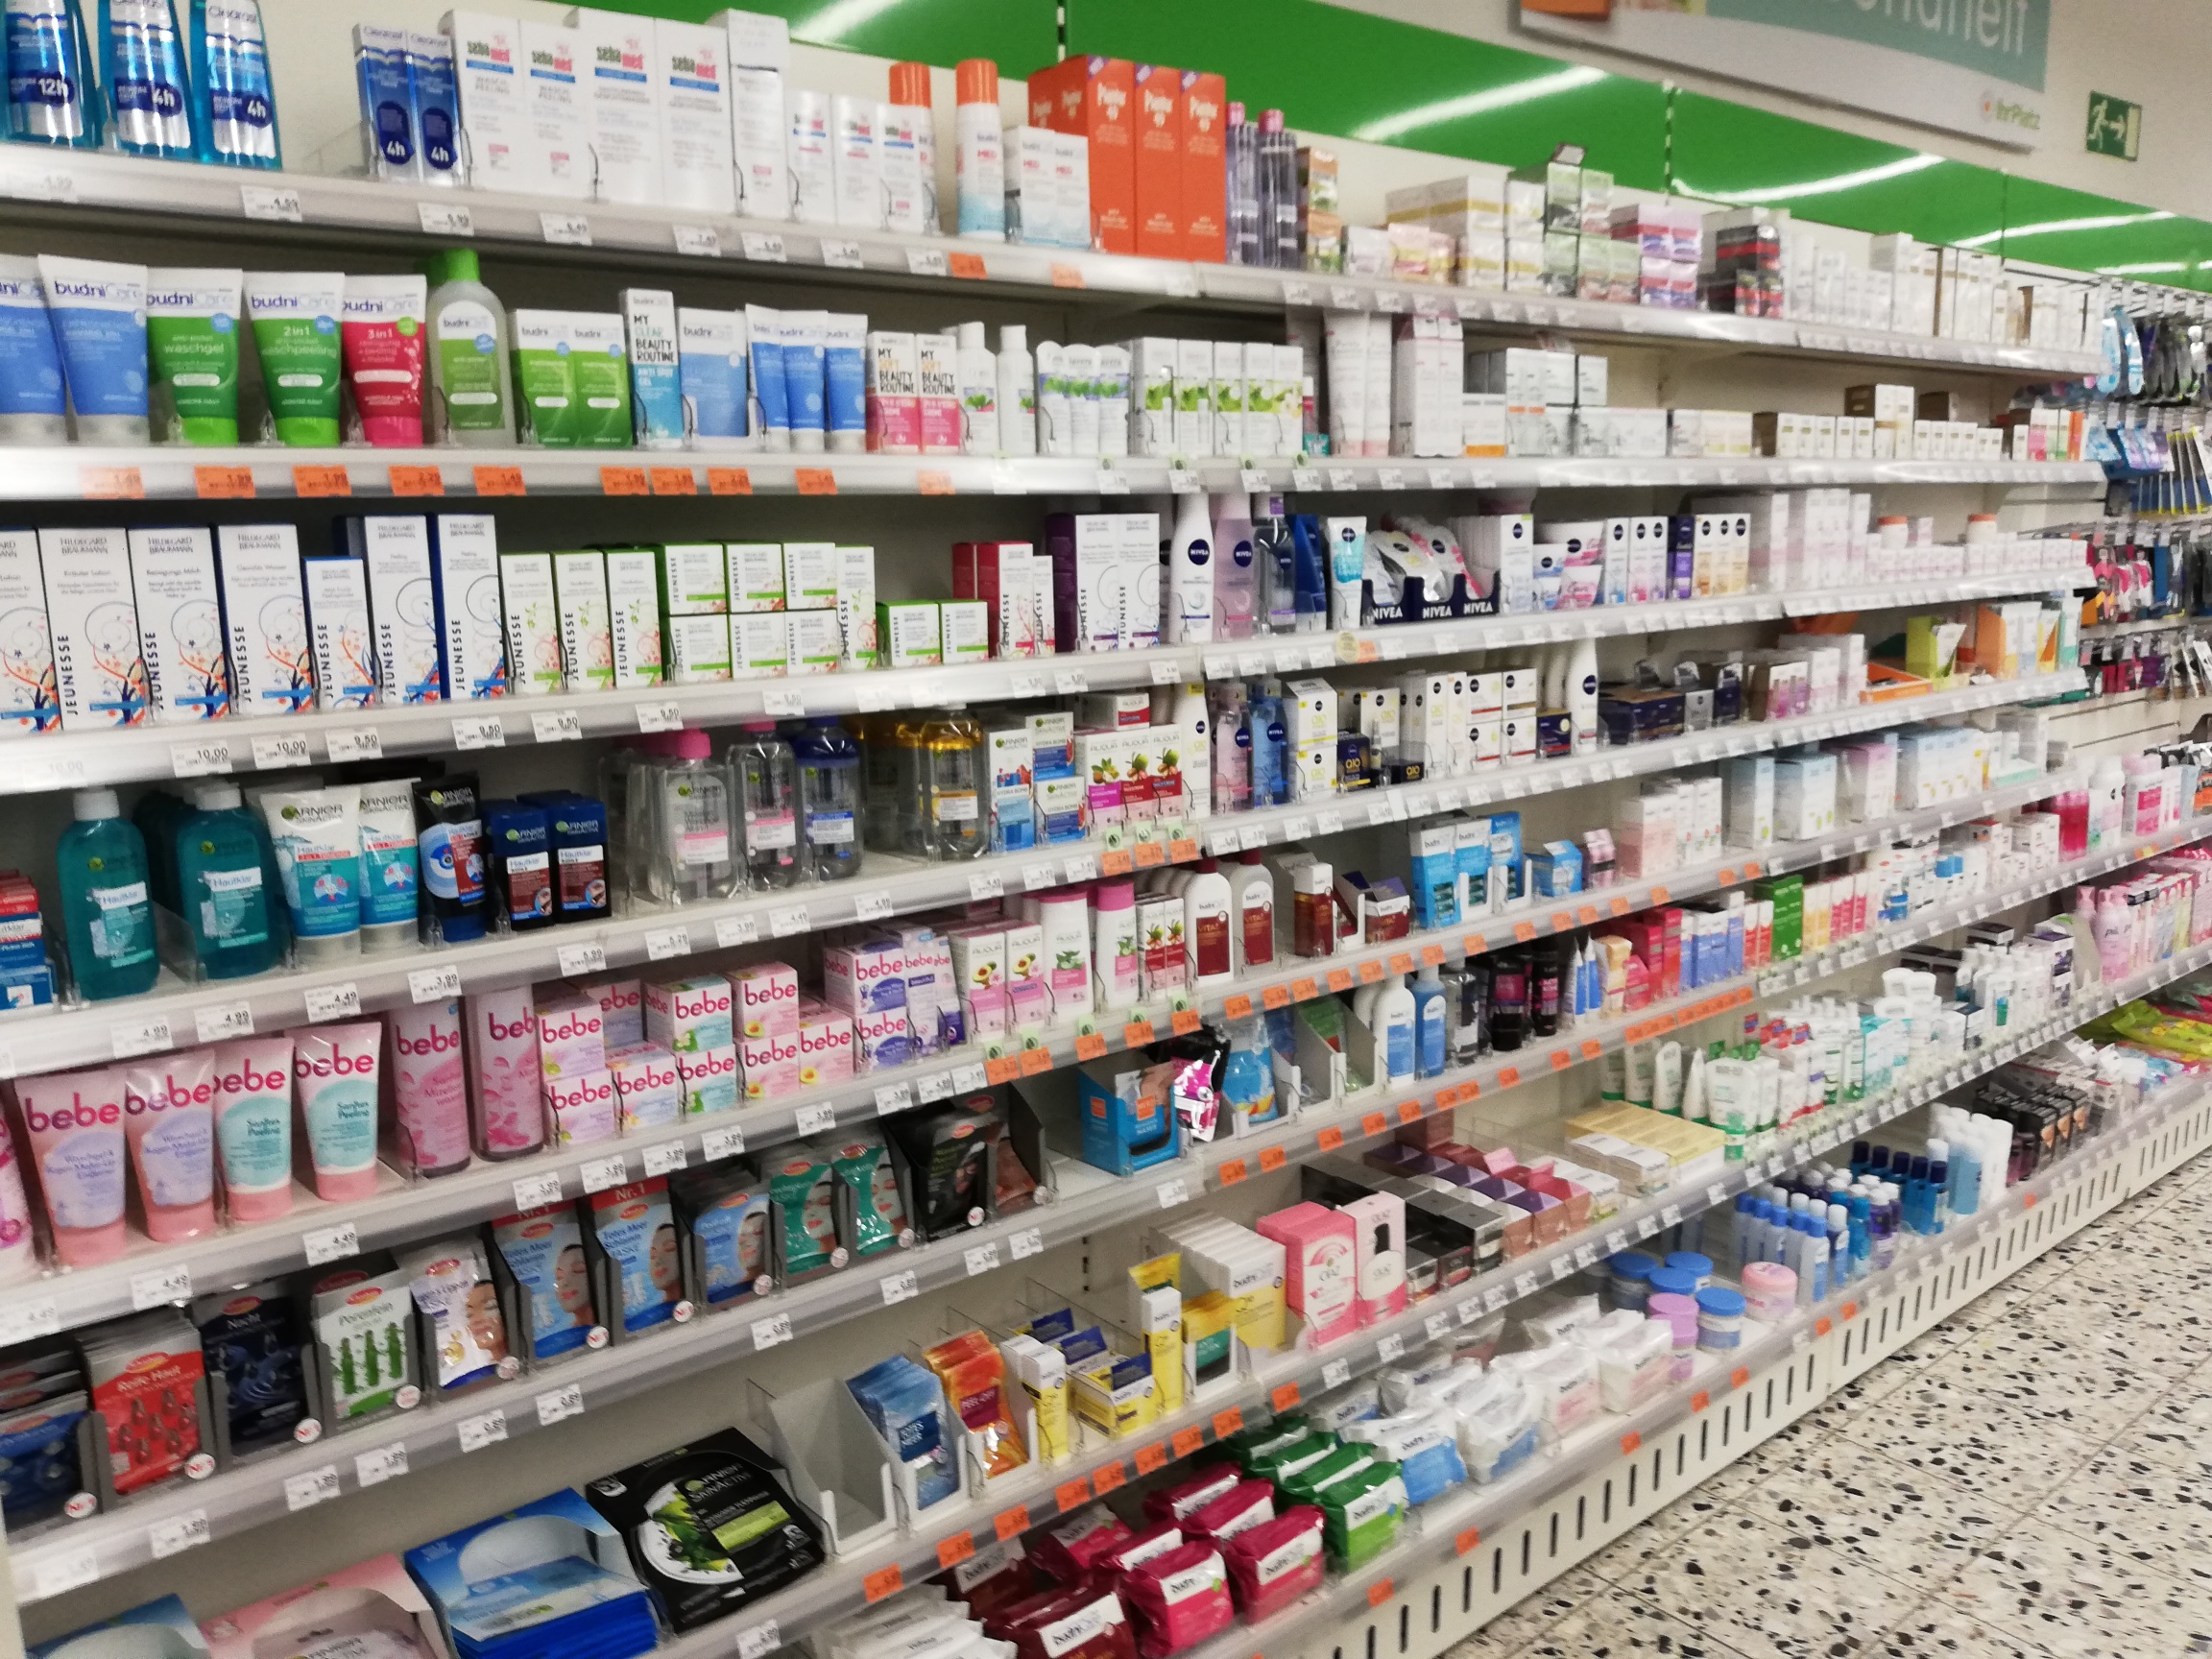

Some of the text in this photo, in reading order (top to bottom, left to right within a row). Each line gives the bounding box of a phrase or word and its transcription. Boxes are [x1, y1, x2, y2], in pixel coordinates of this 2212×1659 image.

[246, 100, 266, 118] 4h
[386, 141, 406, 156] 4h
[431, 146, 449, 162] 4h
[636, 339, 672, 351] BEAUTY
[878, 371, 913, 383] BEAUTY
[922, 373, 955, 385] BEAUTY
[1189, 548, 1210, 558] NIVEA
[1373, 607, 1404, 619] NIVEA
[1422, 606, 1453, 618] NIVEA
[1463, 602, 1494, 614] NIVEA
[451, 618, 466, 690] JEUNESSE
[614, 610, 629, 678] JEUNESSE
[233, 625, 252, 703] JEUNESSE
[316, 624, 334, 700] JEUNESSE
[380, 623, 397, 697] JEUNESSE
[58, 635, 79, 716] JEUNESSE
[854, 953, 903, 981] bebe
[904, 953, 934, 971] bebe
[675, 990, 731, 1020] bebe
[744, 977, 797, 1006] bebe
[396, 1024, 460, 1057] bebe
[542, 1012, 602, 1044] bebe
[800, 1025, 853, 1055] bebe
[858, 1013, 906, 1041] bebe
[294, 1043, 375, 1079] bebe
[678, 1047, 735, 1081] bebe
[744, 1040, 798, 1068] bebe
[550, 1074, 613, 1110] bebe
[617, 1064, 676, 1095] bebe
[125, 1074, 212, 1117] bebe
[25, 1092, 120, 1134] bebe
[615, 1182, 647, 1202] Nr.1
